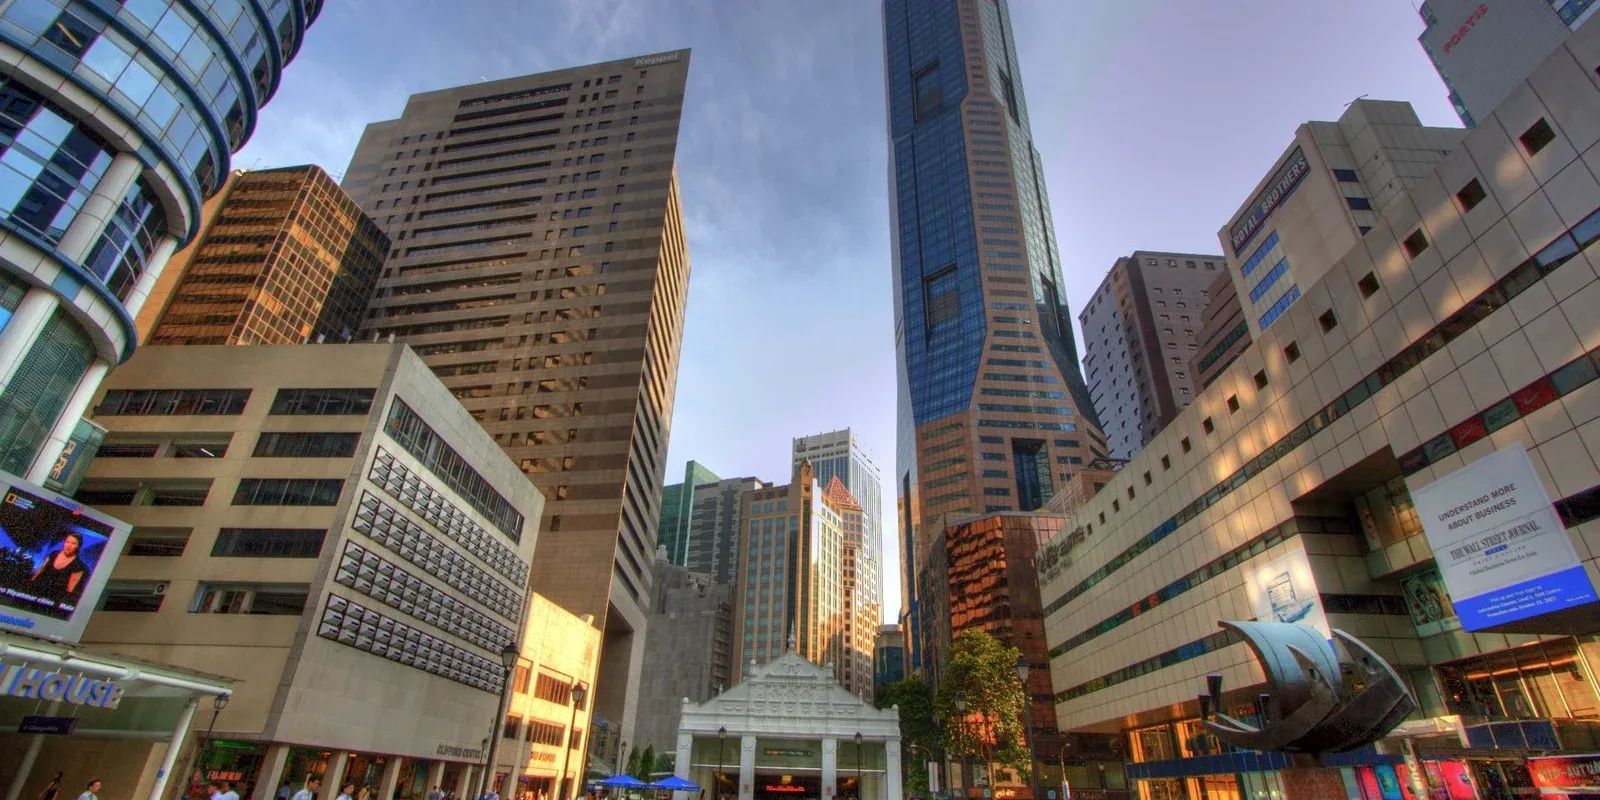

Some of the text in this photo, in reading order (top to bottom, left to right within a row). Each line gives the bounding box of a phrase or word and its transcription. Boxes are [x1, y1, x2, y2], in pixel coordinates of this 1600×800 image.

[1442, 3, 1488, 54] FORTIS
[635, 52, 680, 66] Keppel
[1231, 156, 1308, 249] ROYAL BROTHERS
[50, 440, 76, 479] PURE
[1438, 483, 1517, 522] UNDERSTAND MORE
[1447, 497, 1517, 531] ABOUT BUSINESS
[1449, 547, 1466, 561] THE
[1463, 540, 1482, 557] WALL
[1480, 531, 1509, 549] STREET
[9, 666, 124, 710] HOUSE
[437, 743, 462, 757] CLIFFORD
[207, 770, 243, 781] FUJIFILM
